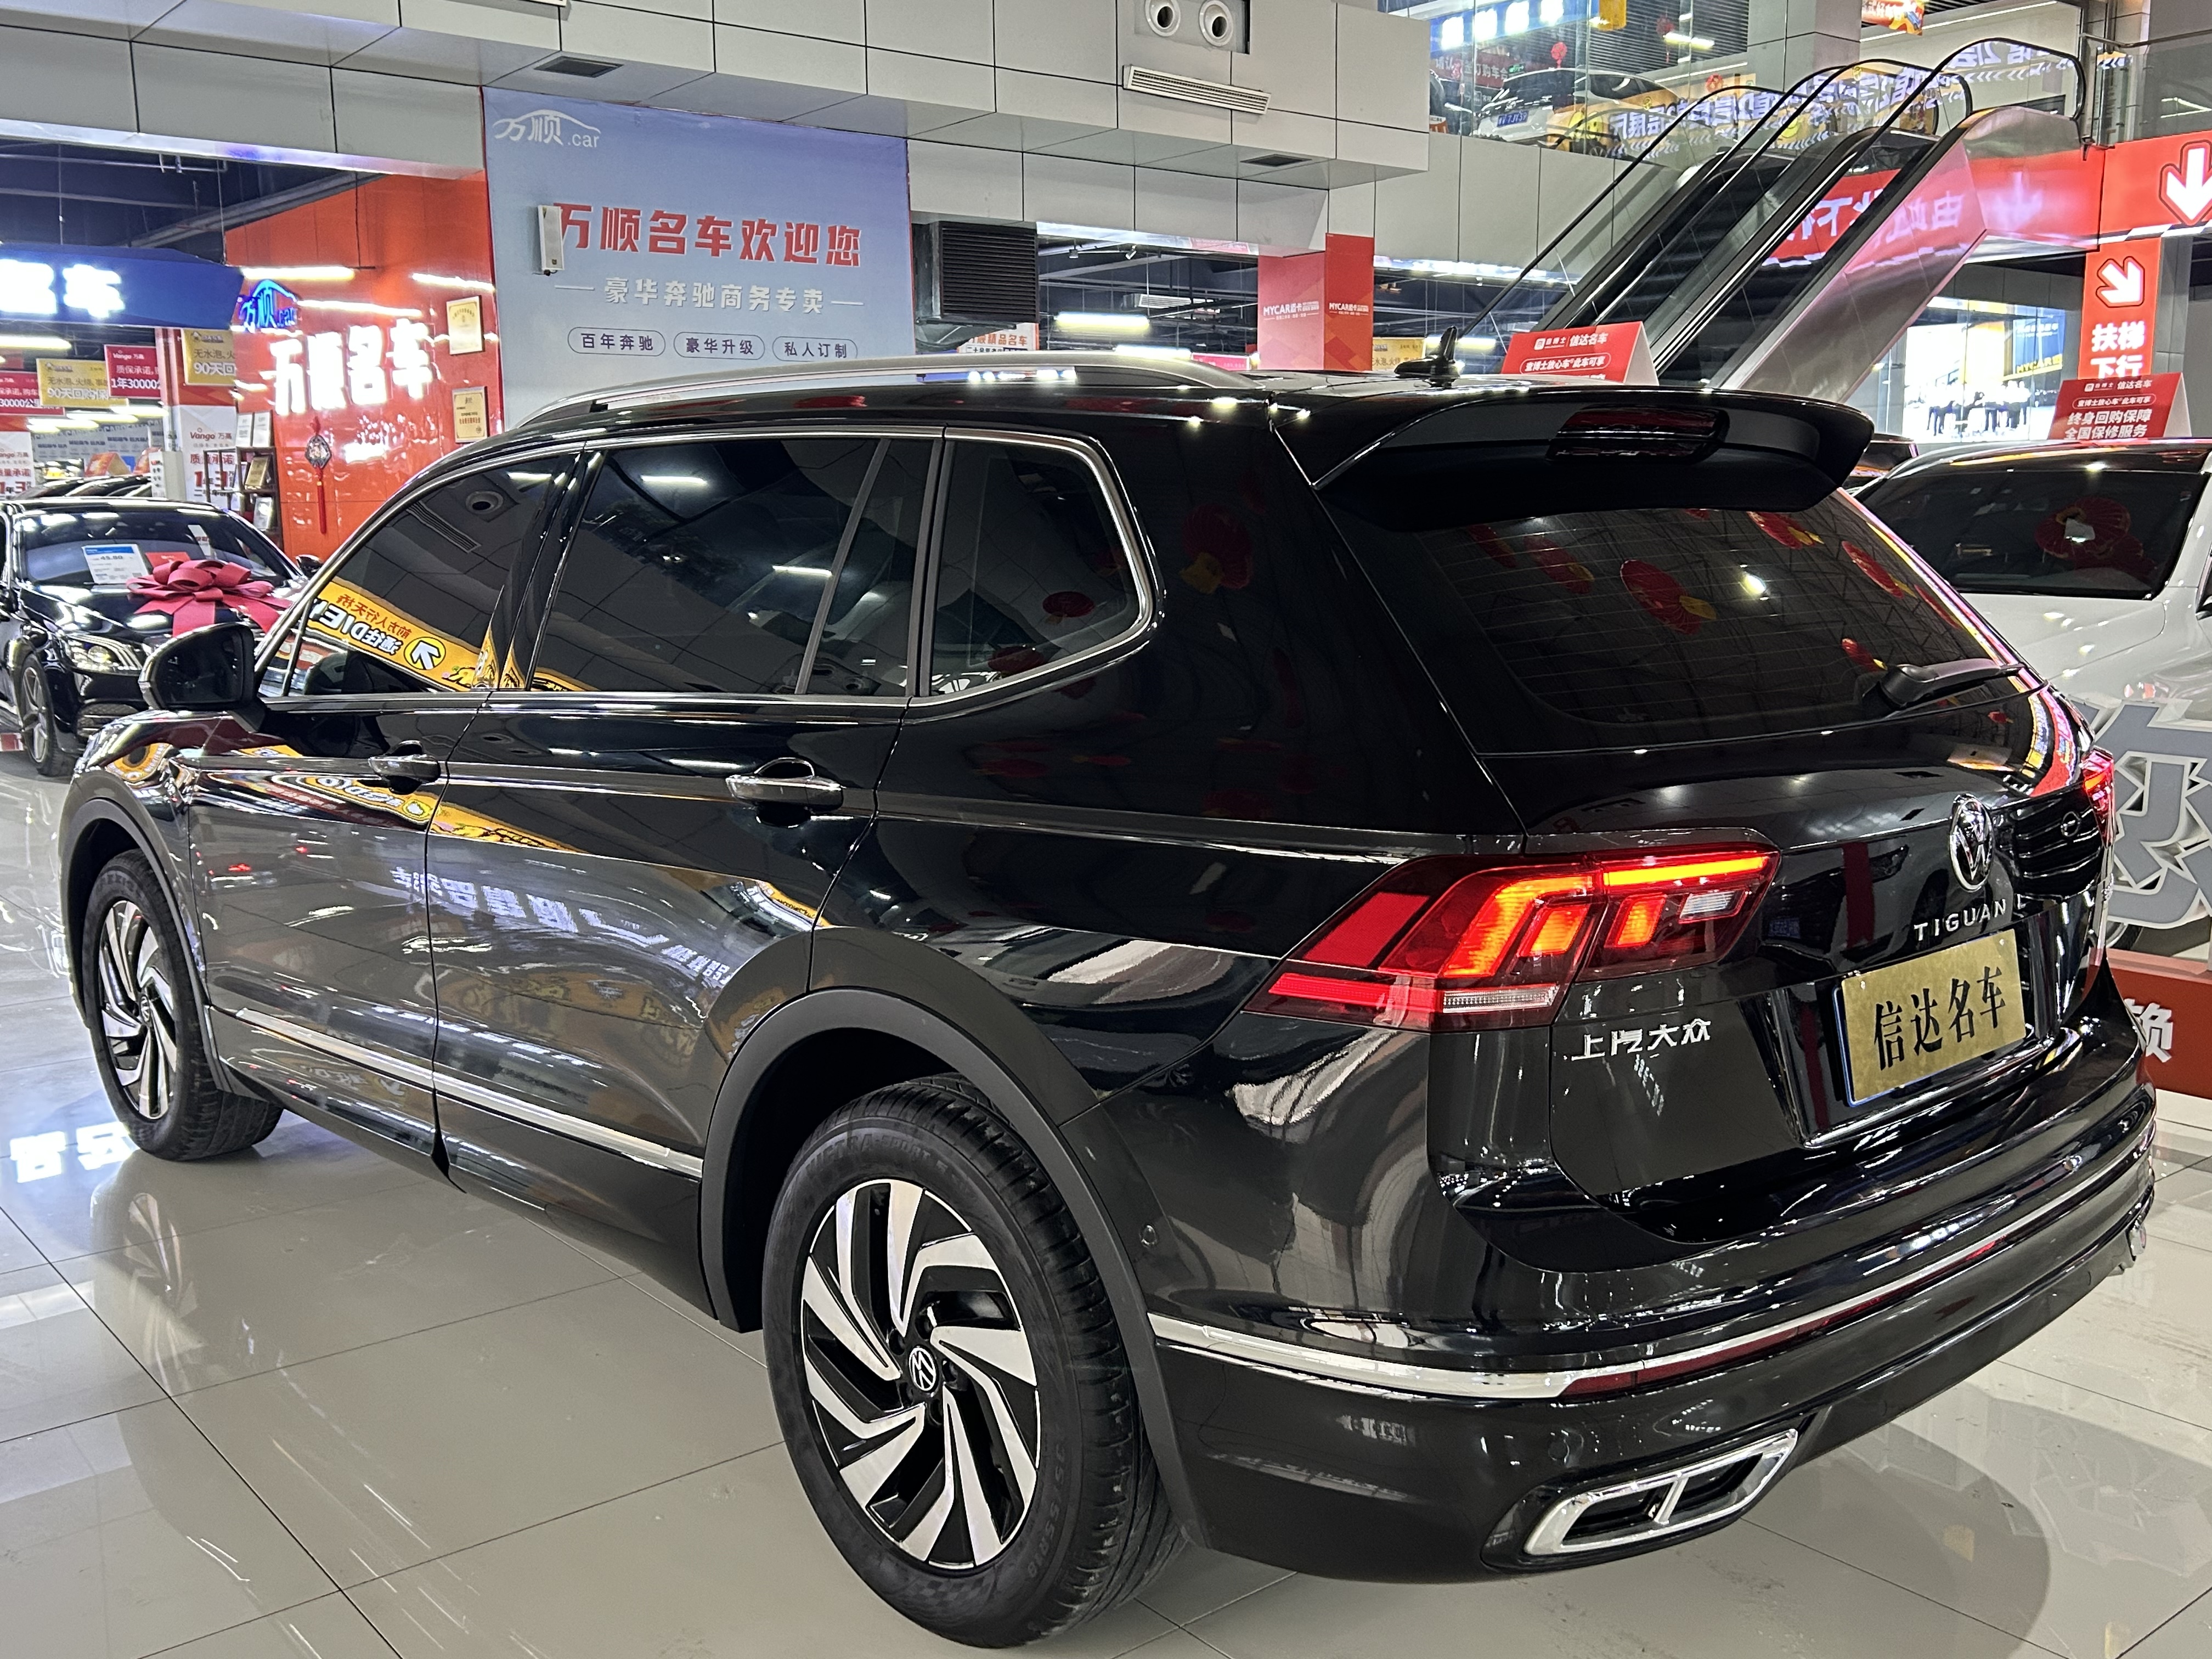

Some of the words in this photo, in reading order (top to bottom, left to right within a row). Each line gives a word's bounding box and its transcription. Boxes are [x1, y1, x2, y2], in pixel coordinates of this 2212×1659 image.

[553, 202, 861, 267] 万顺名车欢迎您
[604, 277, 824, 314] 豪华奔驰商务专卖
[580, 332, 654, 352] 百年奔驰
[686, 336, 755, 356] 豪华升级
[784, 341, 848, 358] 私人订制
[1570, 332, 1609, 347] 信达名车
[2091, 320, 2145, 352] 扶梯
[2090, 354, 2143, 379] 下行
[2117, 380, 2153, 390] 信达名车
[2064, 424, 2147, 440] 全国保修服务
[2067, 409, 2152, 426] 终身回购保障
[1914, 899, 2007, 941] TIGUAN
[1874, 966, 2006, 1070] 信达名车
[1571, 1018, 1711, 1061] 上汽大众
